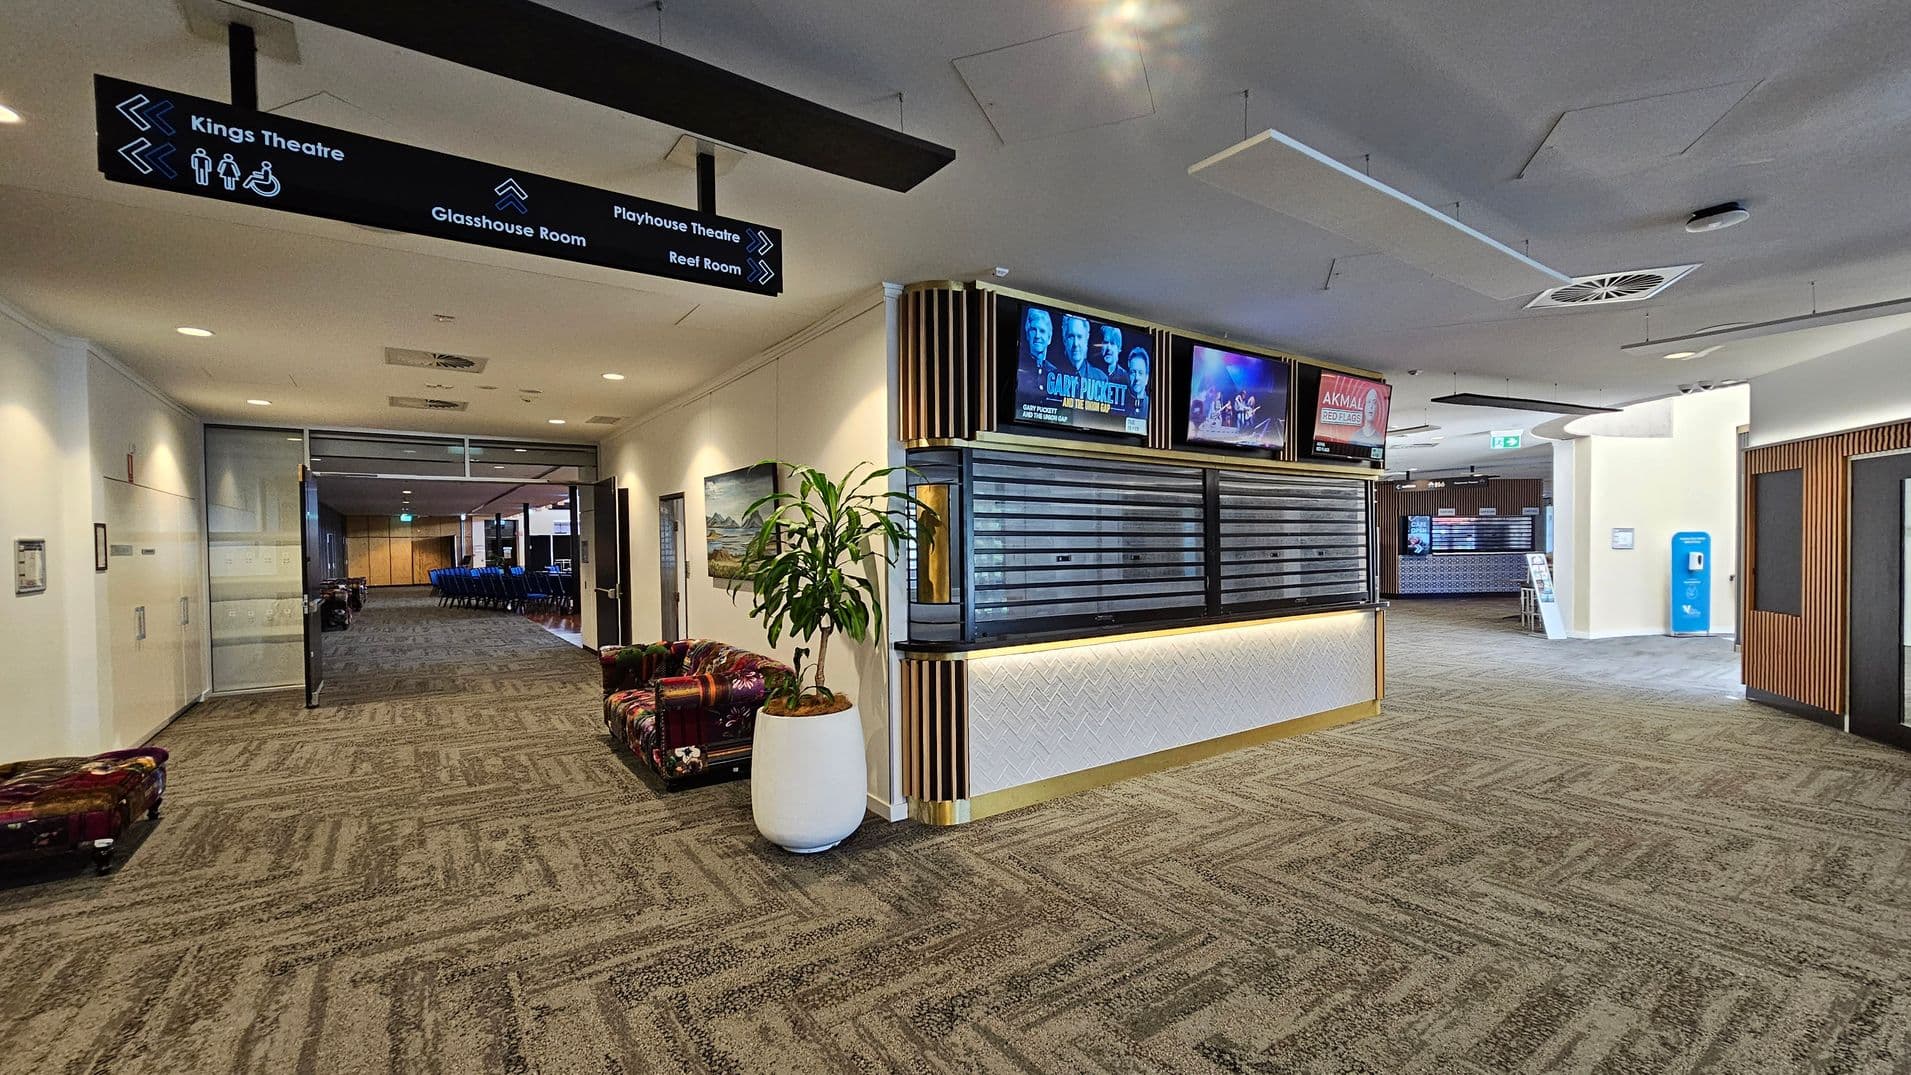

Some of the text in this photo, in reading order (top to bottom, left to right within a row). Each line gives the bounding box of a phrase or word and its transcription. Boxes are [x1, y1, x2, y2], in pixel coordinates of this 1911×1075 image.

[191, 115, 345, 161] Kings Theatre
[431, 206, 587, 247] Glasshouse Room
[613, 205, 741, 243] Playhouse Theatre
[669, 250, 742, 276] Reef Room
[1046, 372, 1127, 406] GARY PUCKETT
[1322, 391, 1363, 410] AKMAL
[1022, 404, 1058, 415] GARY PUCKETT
[1062, 397, 1074, 408] AND
[1074, 399, 1084, 410] THE
[1322, 411, 1361, 423] RED FLAGS
